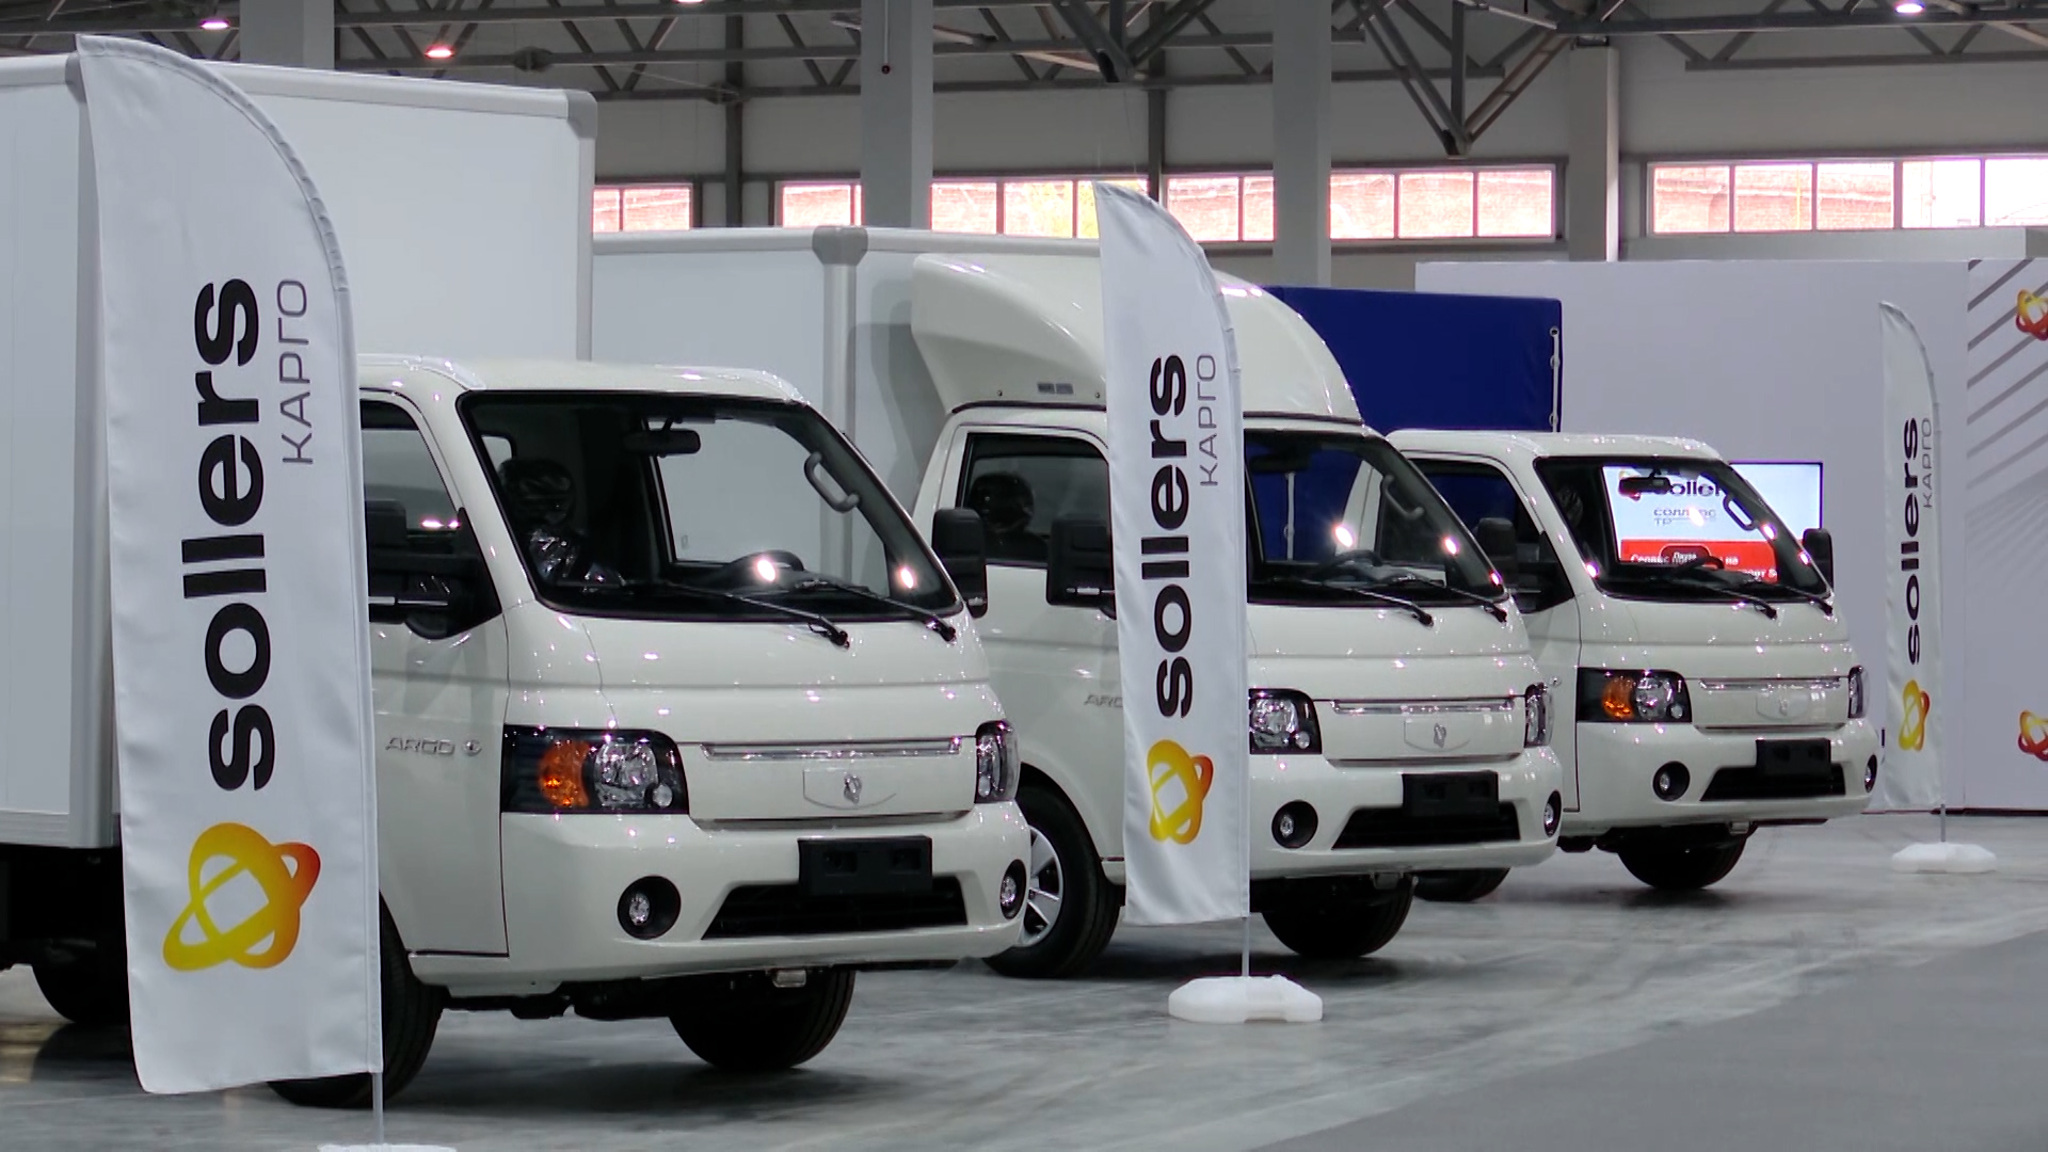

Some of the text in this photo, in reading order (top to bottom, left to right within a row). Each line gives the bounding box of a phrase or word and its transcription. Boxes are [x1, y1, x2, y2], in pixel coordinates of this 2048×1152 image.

[276, 279, 313, 465] КАРГО
[1196, 354, 1219, 486] КАРГО
[1921, 417, 1934, 509] КАРГО
[181, 278, 275, 791] sollers
[1140, 354, 1193, 719] sollers
[1900, 417, 1921, 665] sollers
[384, 737, 456, 756] ARGO
